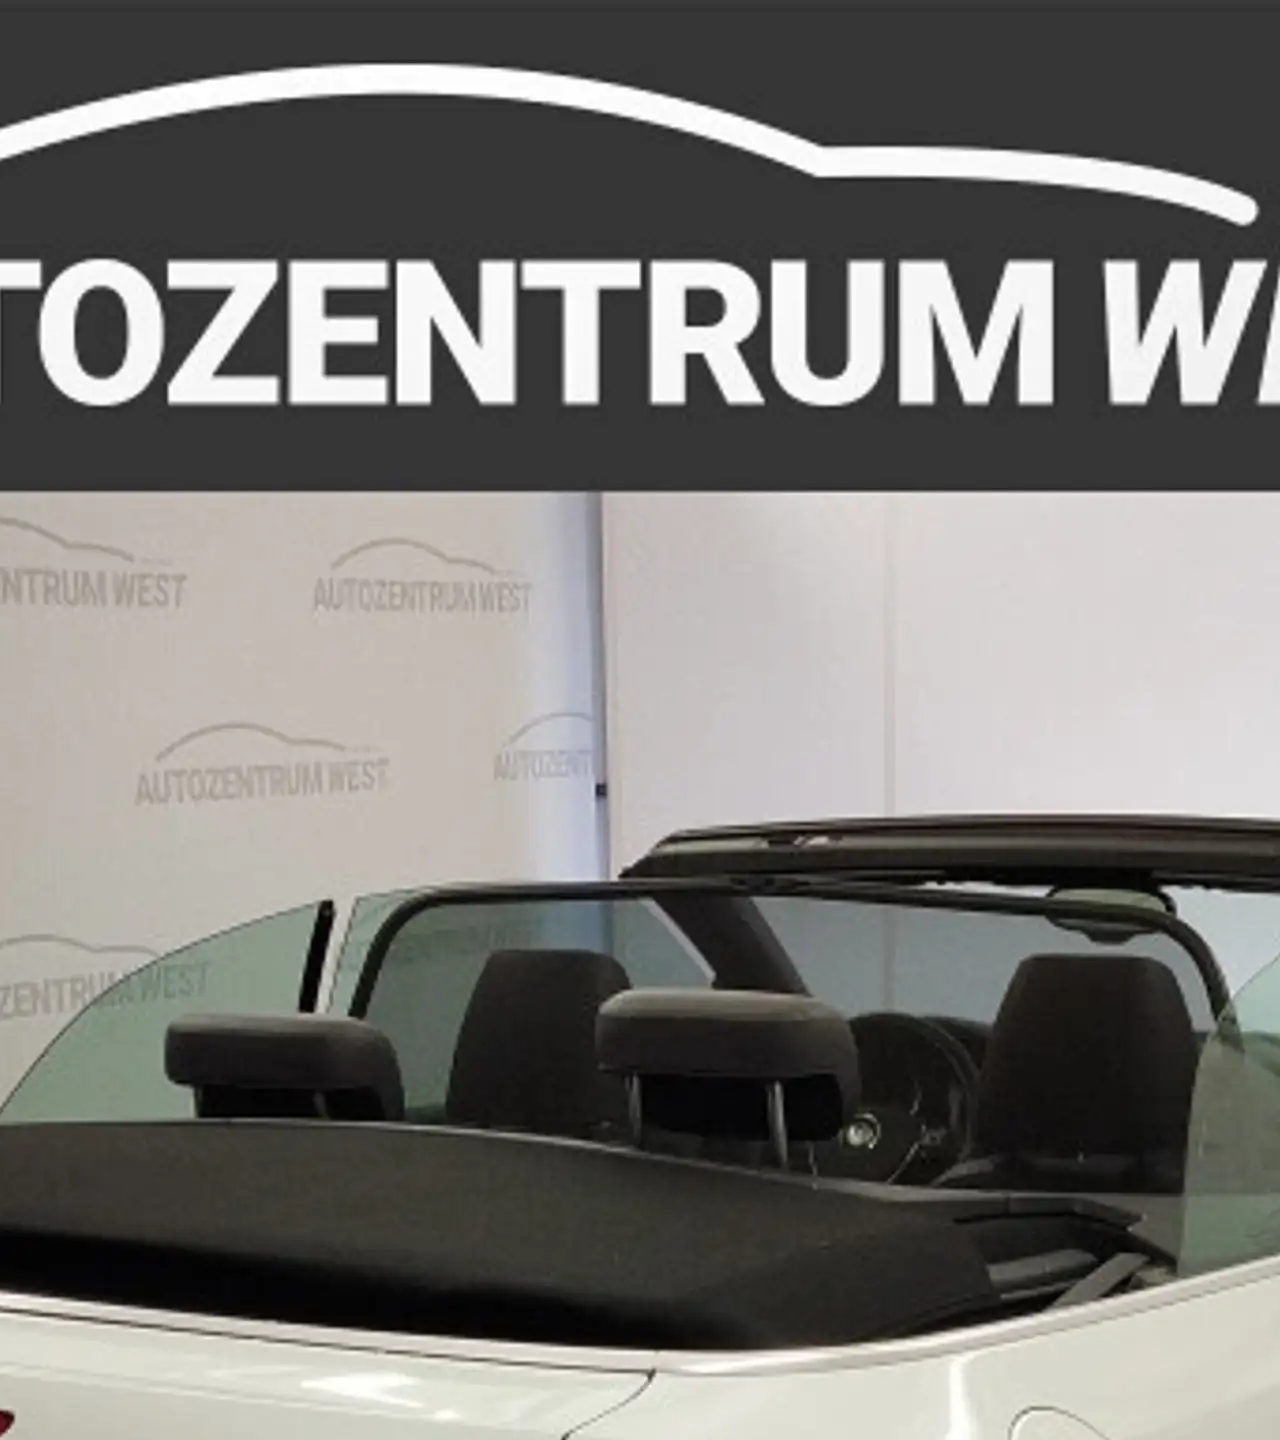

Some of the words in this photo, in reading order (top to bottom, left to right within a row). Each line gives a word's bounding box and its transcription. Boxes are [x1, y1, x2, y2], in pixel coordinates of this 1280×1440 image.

[113, 571, 188, 609] WEST
[314, 576, 477, 613] AUTOZENTRUM
[478, 580, 532, 613] WEST
[135, 761, 323, 806] AUTOZENTRUM
[329, 757, 390, 795] WEST
[138, 961, 210, 1003] WEST
